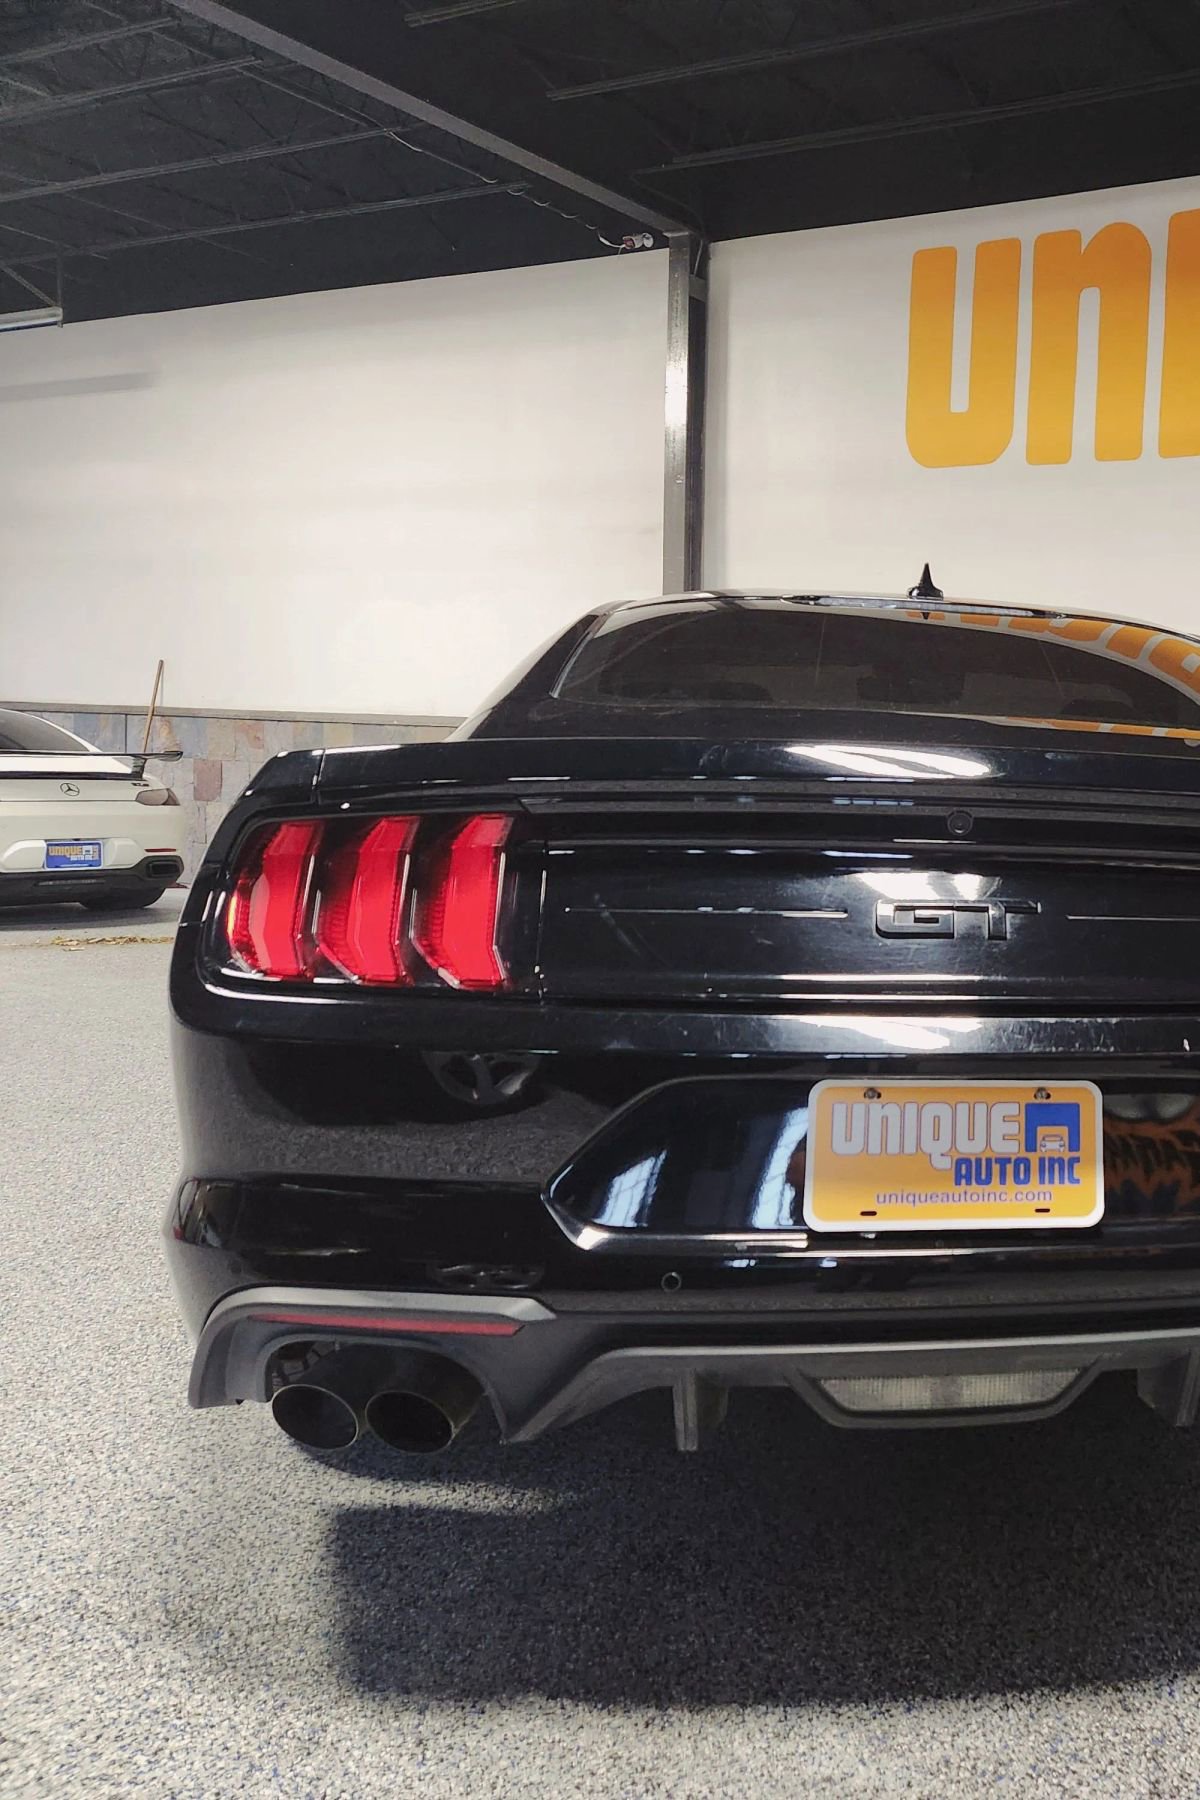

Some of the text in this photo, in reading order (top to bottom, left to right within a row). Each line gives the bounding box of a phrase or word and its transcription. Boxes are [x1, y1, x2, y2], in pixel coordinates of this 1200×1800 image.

[875, 900, 1042, 940] GT
[831, 1102, 1020, 1170] UNIQUE
[954, 1157, 1080, 1186] AUTO INC
[876, 1188, 1053, 1207] uniqueautoinc.com
